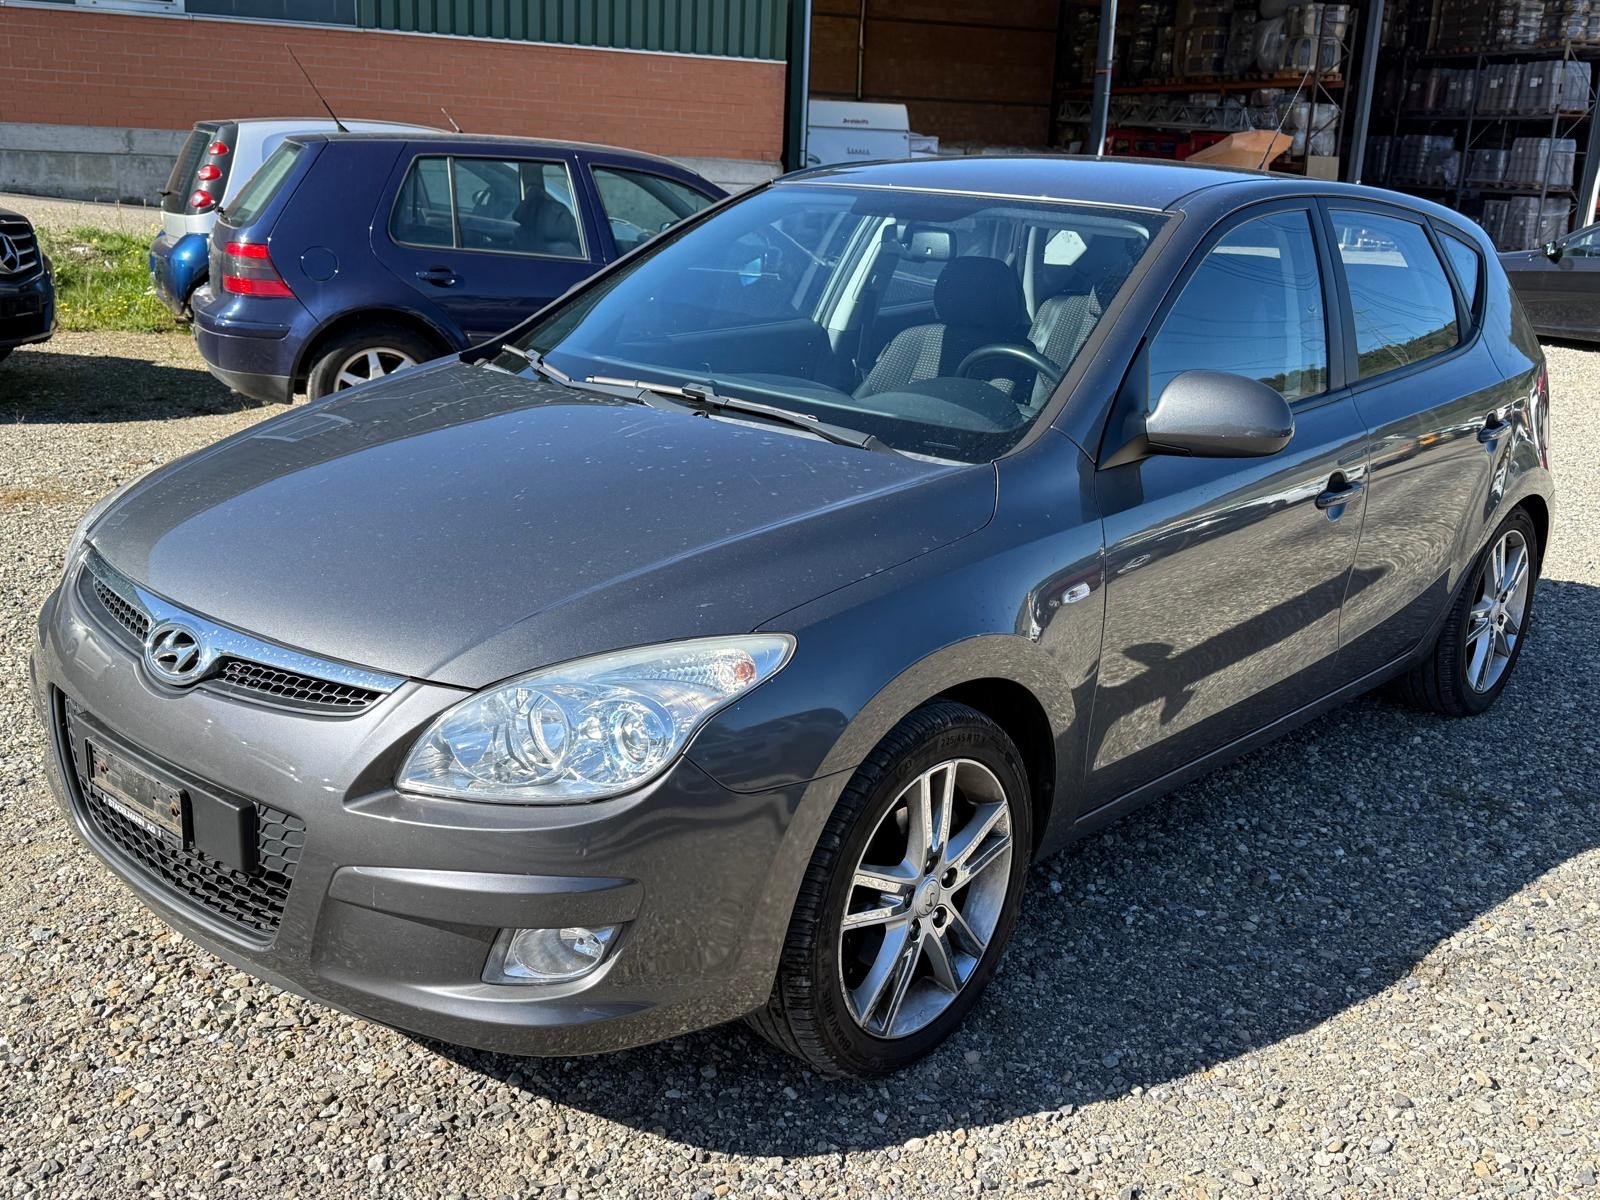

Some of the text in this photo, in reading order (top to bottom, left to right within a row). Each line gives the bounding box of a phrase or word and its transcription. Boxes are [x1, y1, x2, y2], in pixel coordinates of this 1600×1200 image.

[108, 797, 156, 832] STADELMANN AG
[821, 989, 851, 1051] BRAVURIS
